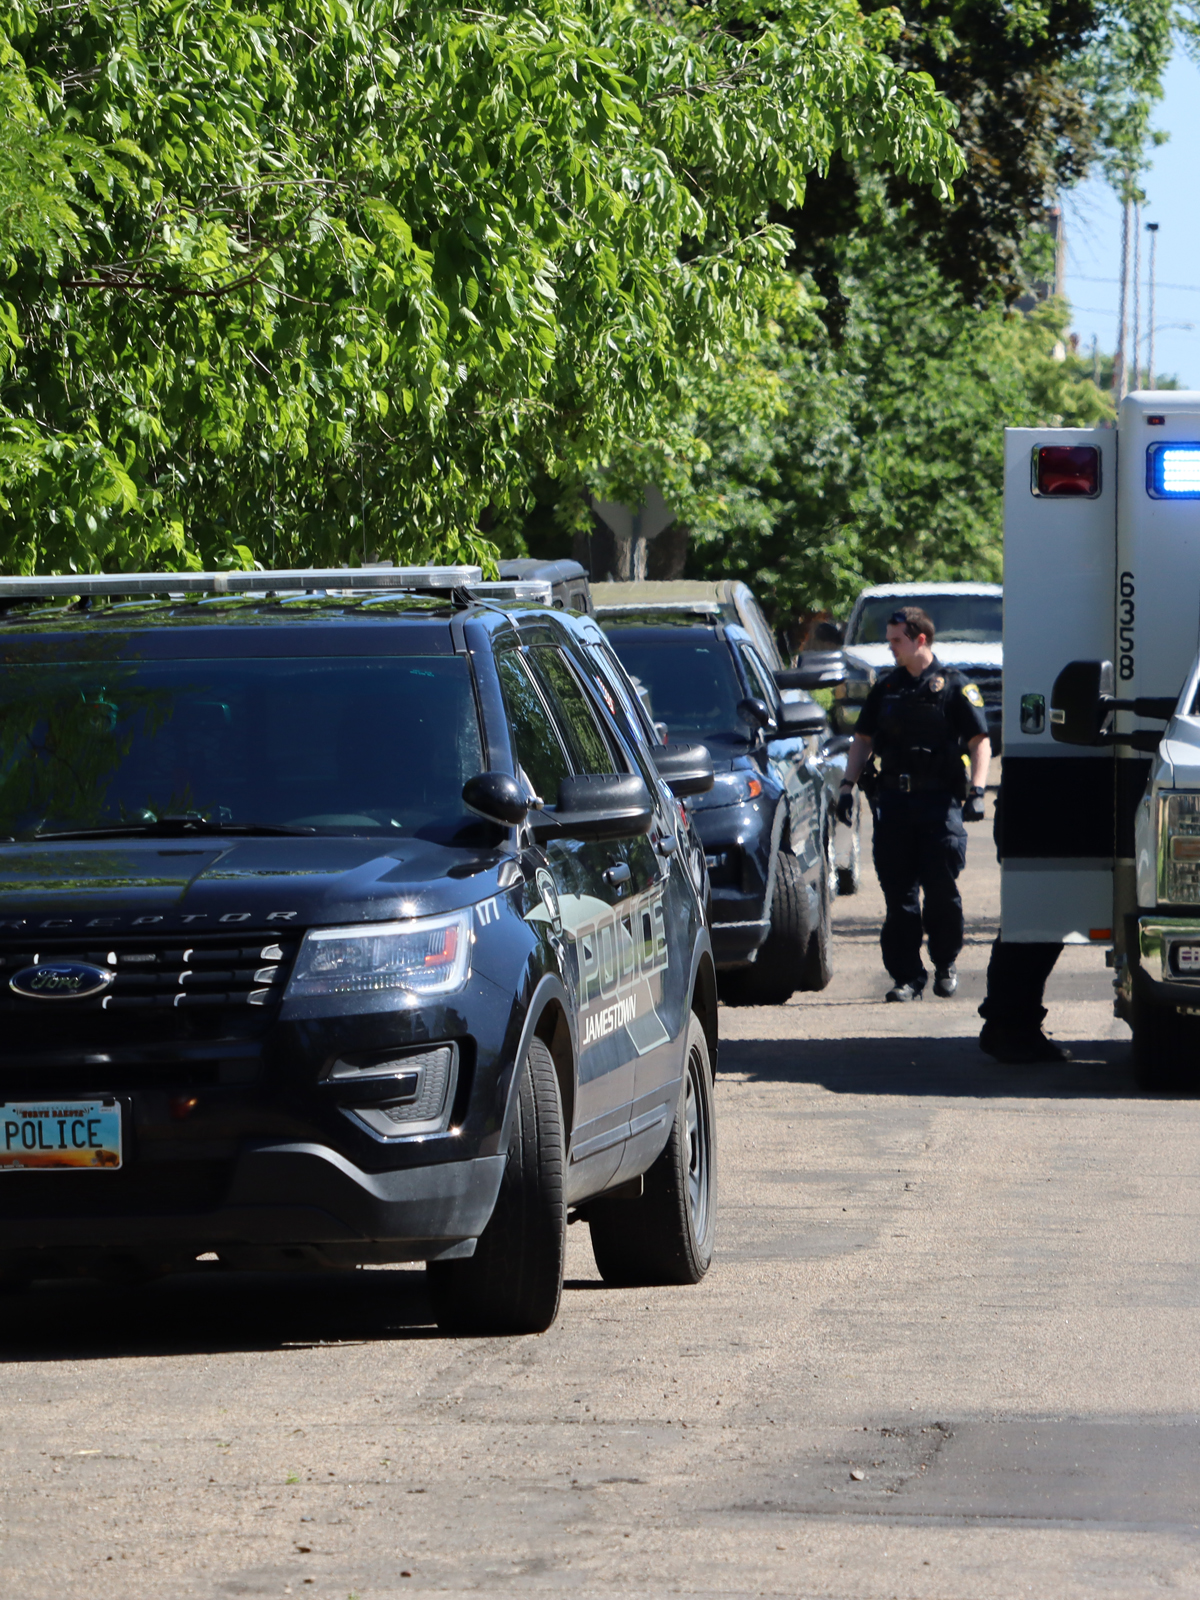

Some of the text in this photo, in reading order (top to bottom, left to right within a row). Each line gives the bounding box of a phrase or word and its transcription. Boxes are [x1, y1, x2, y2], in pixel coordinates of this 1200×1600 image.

[1120, 571, 1135, 681] 6358
[575, 884, 669, 1012] POLICE
[31, 967, 83, 989] Ford
[582, 993, 638, 1046] JAMESTOWN
[4, 1119, 103, 1150] POLICE
[21, 1109, 85, 1118] NORTH DAKOTA
